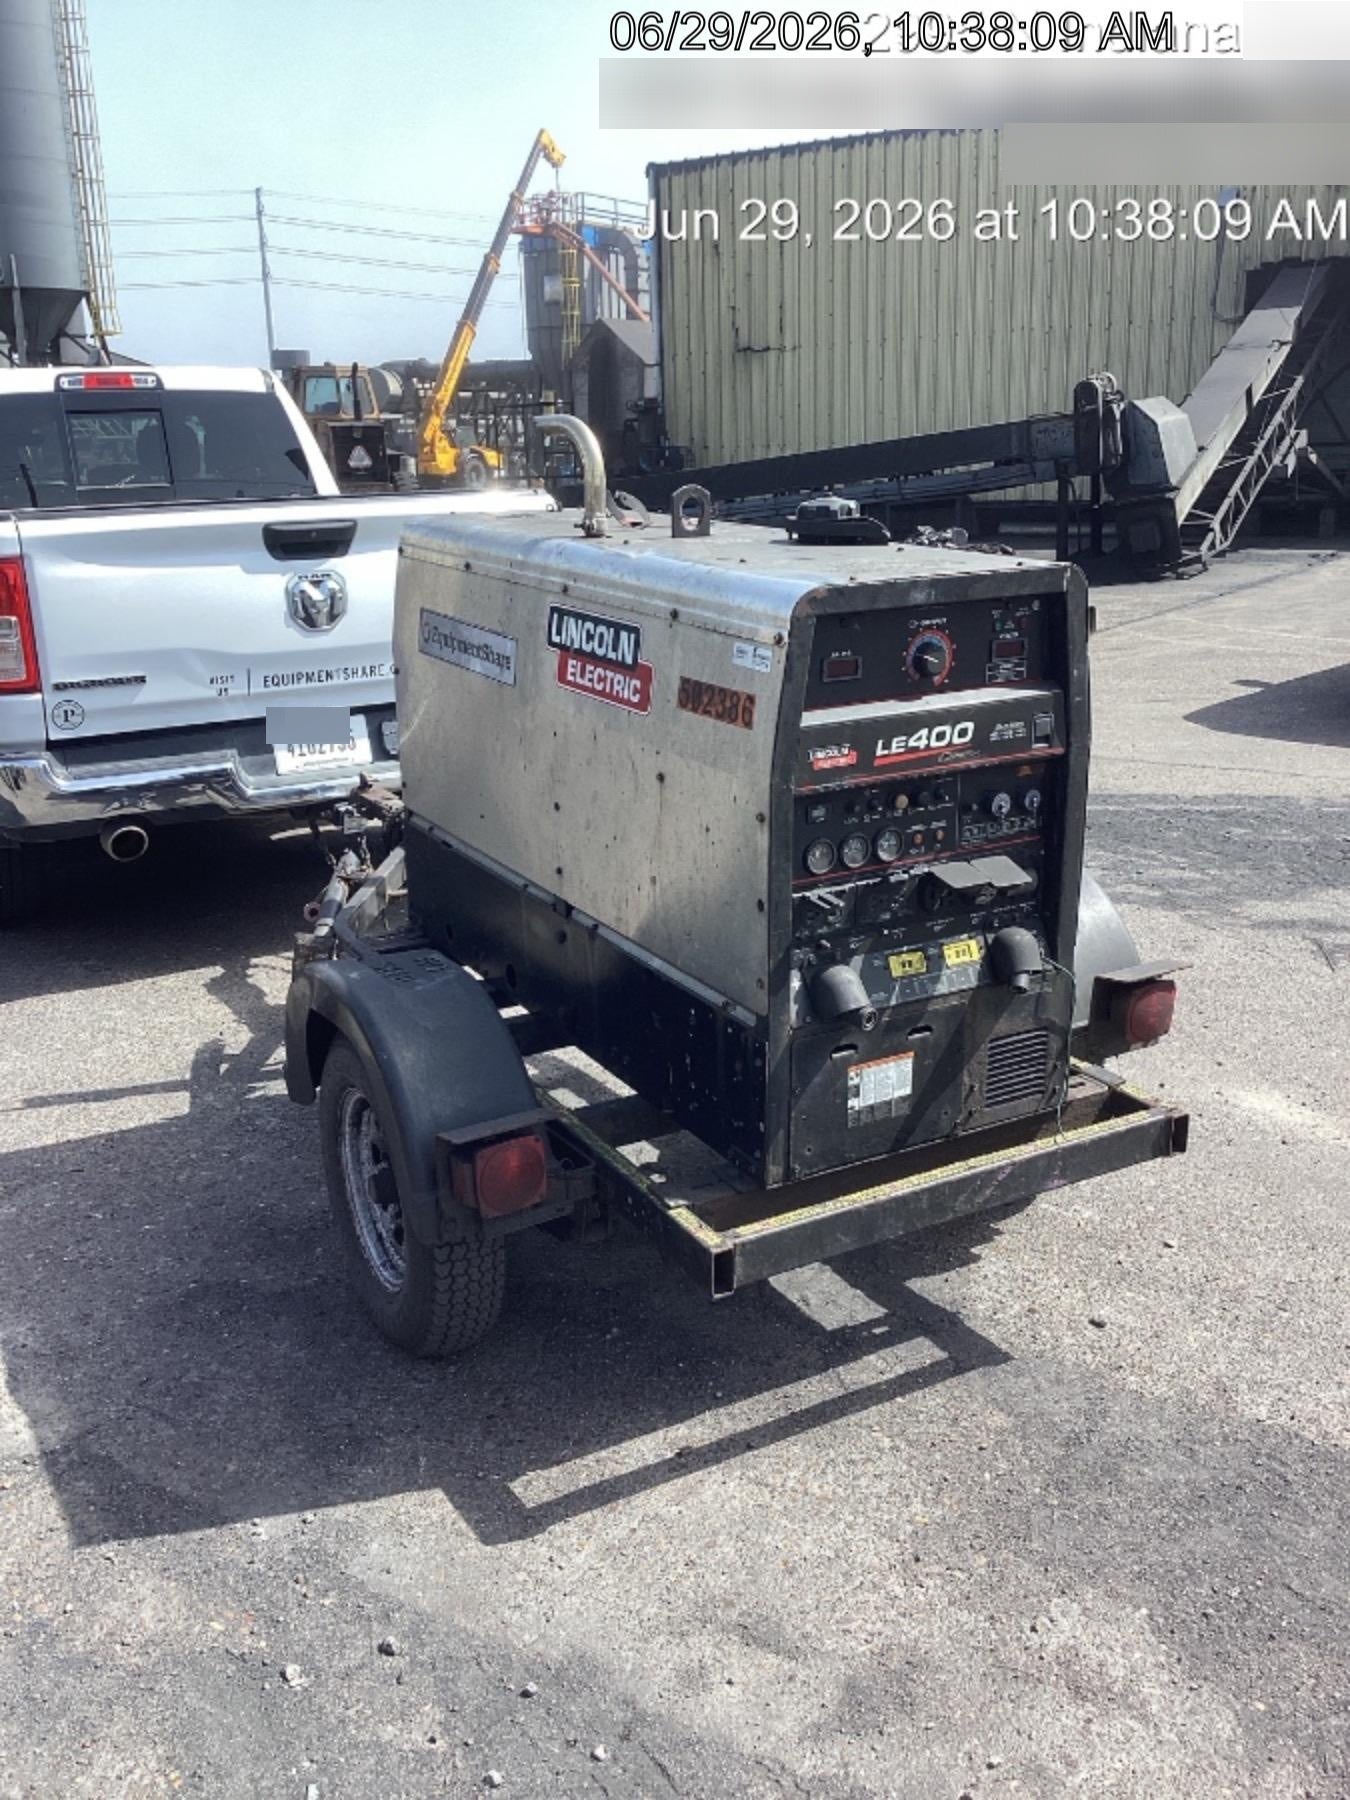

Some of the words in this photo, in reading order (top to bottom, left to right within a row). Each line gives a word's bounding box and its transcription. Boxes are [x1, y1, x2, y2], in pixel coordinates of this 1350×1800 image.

[550, 612, 636, 667] LINCOLN
[567, 658, 642, 704] ELECTRIC
[874, 720, 976, 758] LE400
